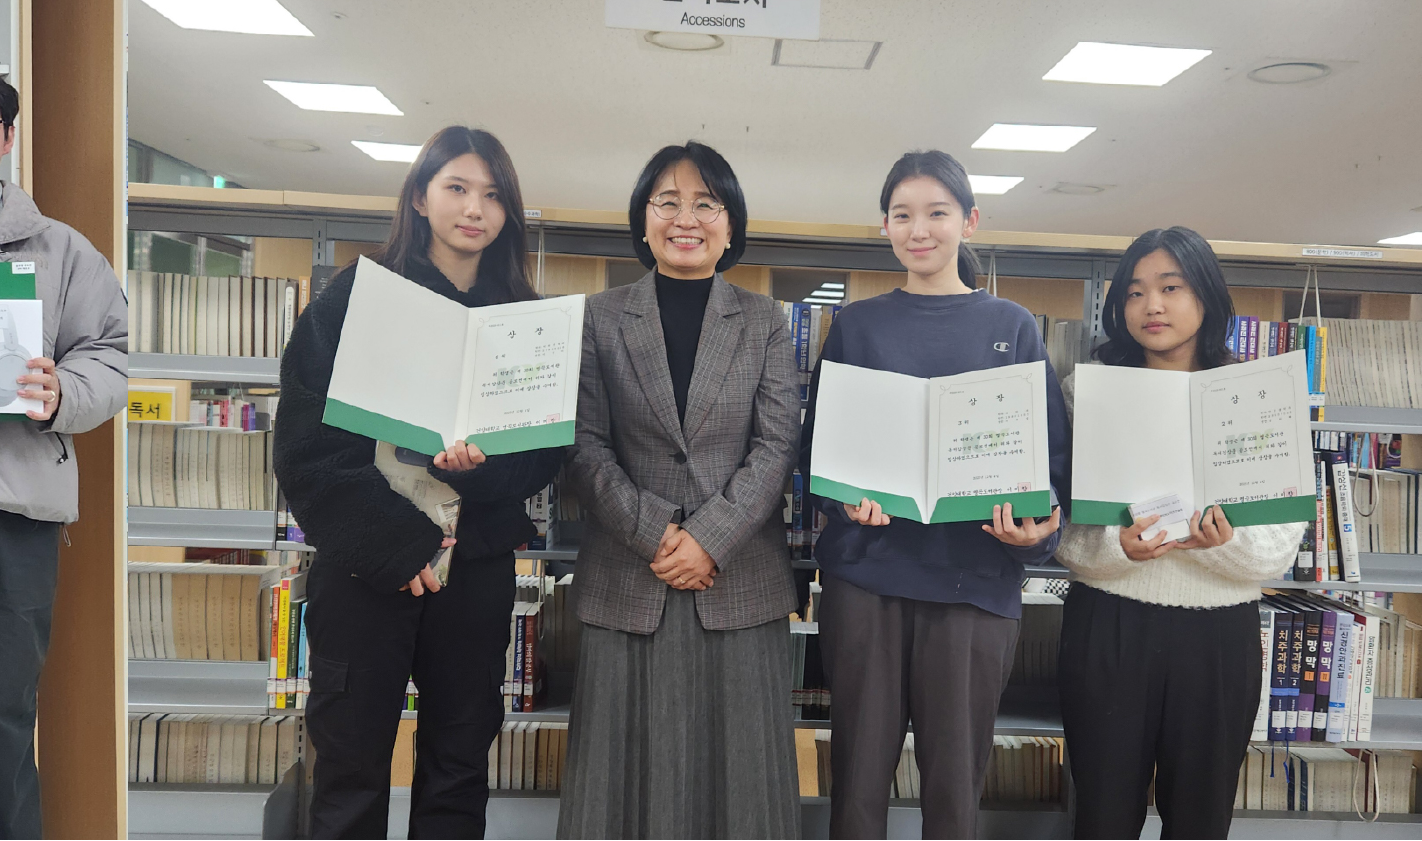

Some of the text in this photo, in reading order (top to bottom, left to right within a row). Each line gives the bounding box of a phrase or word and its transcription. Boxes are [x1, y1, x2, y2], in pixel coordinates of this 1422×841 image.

[680, 12, 746, 28] Accessions
[508, 327, 544, 339] 상 장
[968, 394, 1004, 406] 상 장
[1231, 389, 1267, 404] 상 장
[128, 402, 162, 420] 독서
[1277, 630, 1288, 674] 치주과학
[1291, 630, 1303, 674] 치주과학
[1306, 640, 1317, 668] 망막
[1321, 641, 1333, 669] 망막
